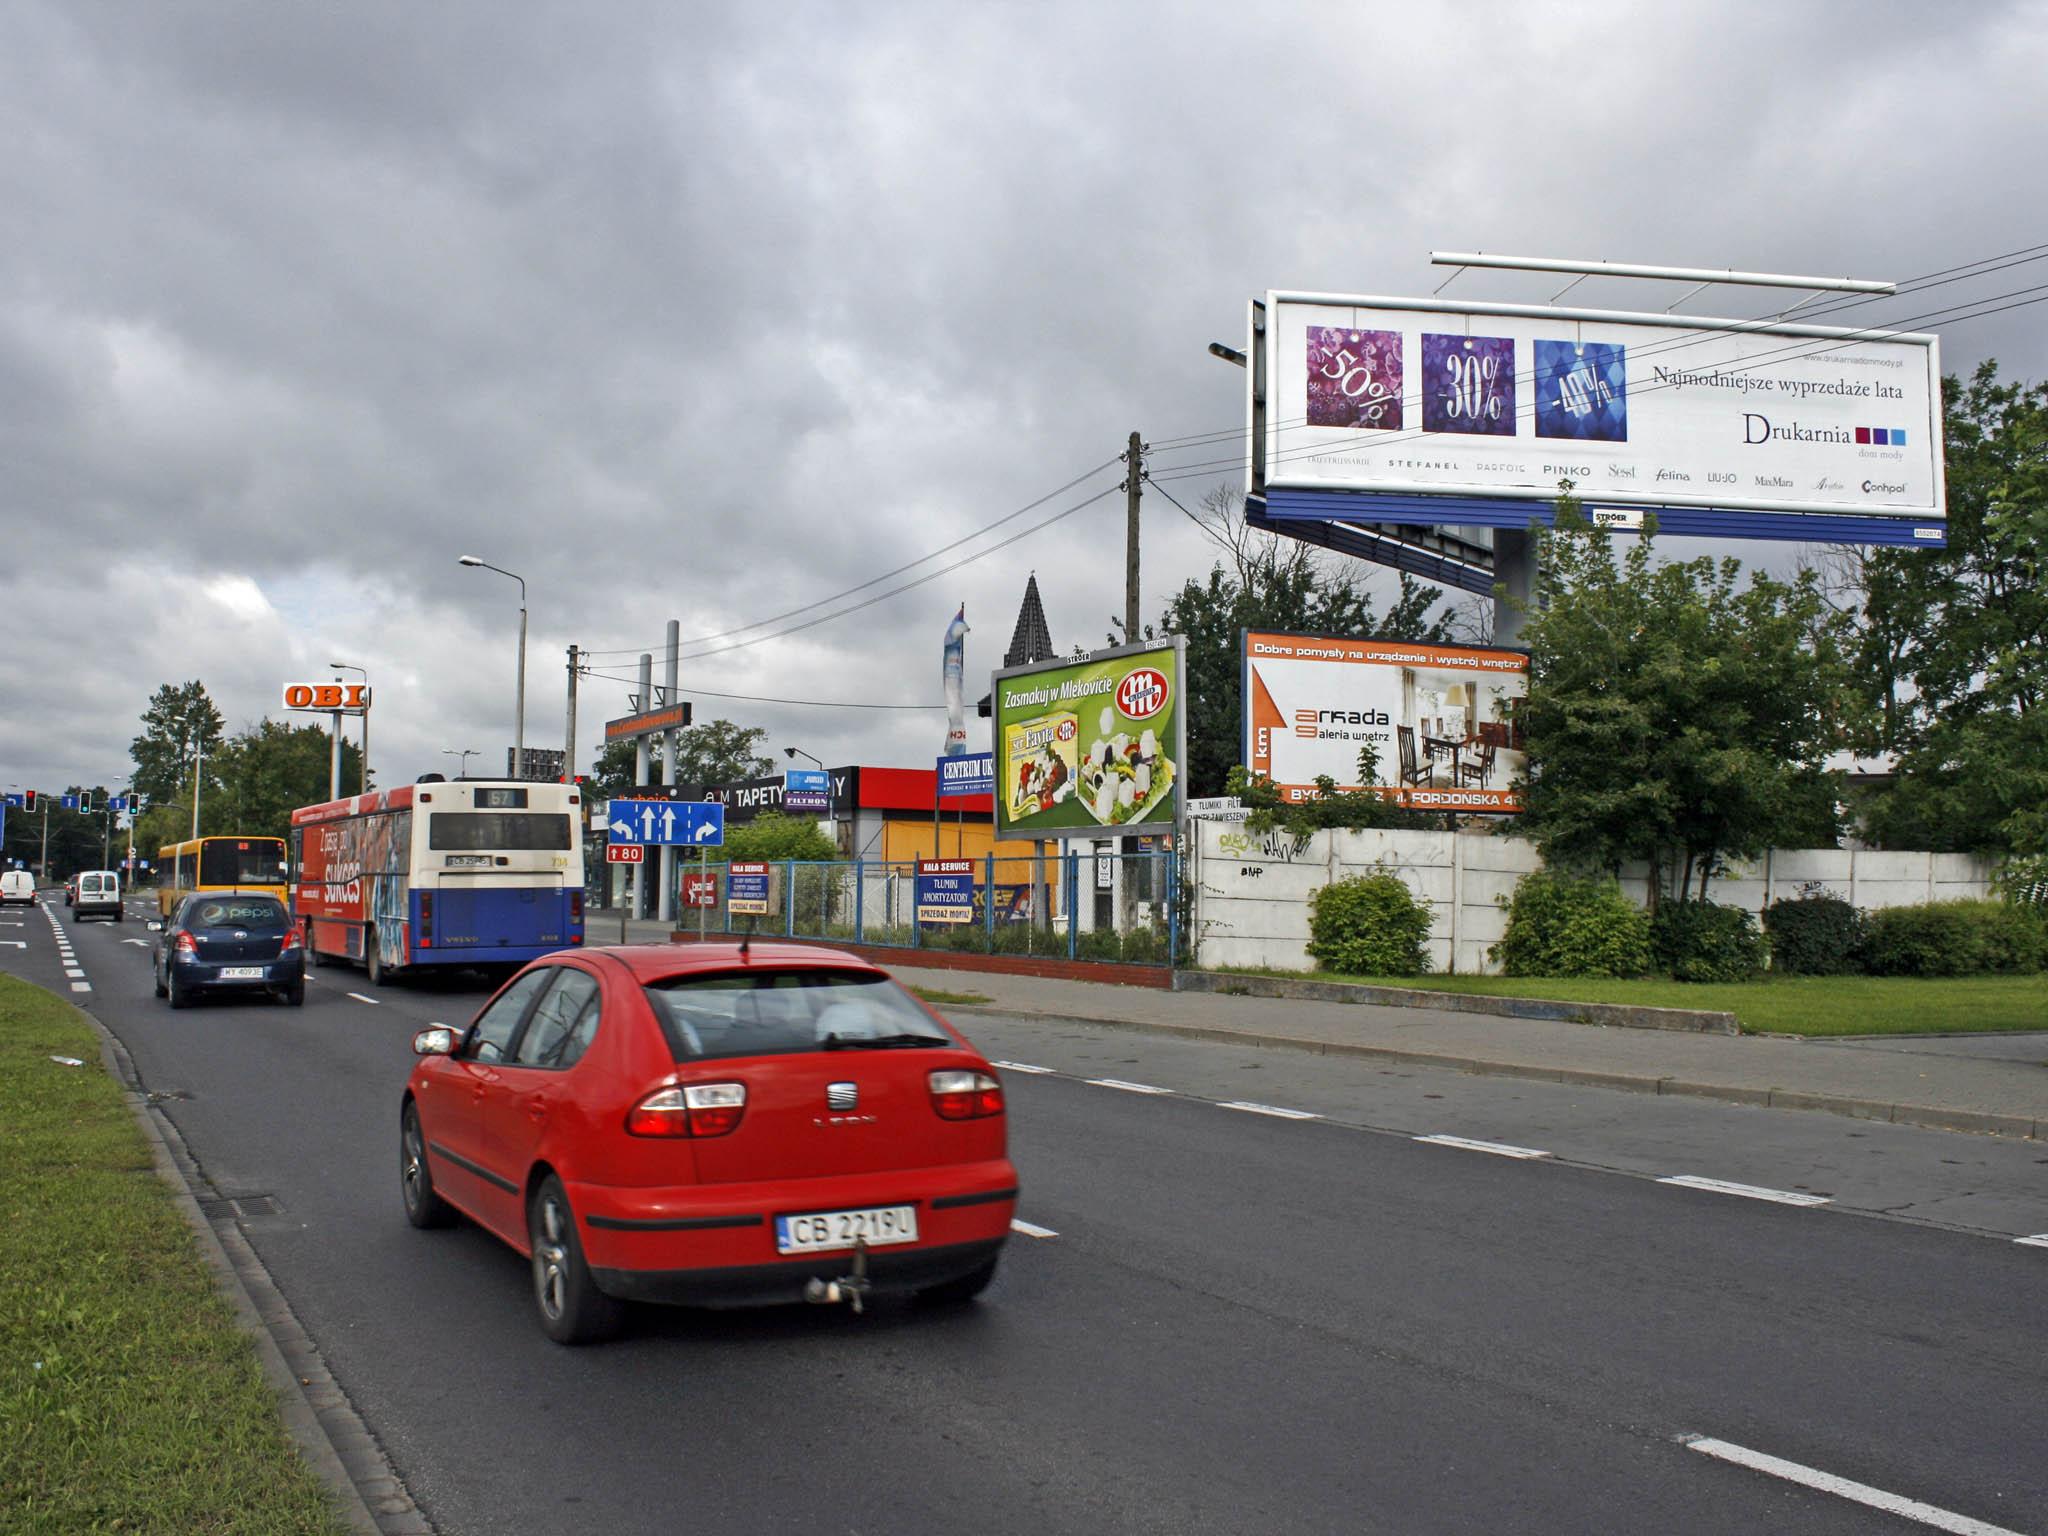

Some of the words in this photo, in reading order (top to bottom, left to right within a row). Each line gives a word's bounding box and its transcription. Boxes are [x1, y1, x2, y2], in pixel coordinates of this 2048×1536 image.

[1320, 347, 1393, 421] -50%
[1438, 354, 1501, 421] -30%
[1552, 363, 1613, 418] -40%
[1653, 366, 1774, 394] Najmodniejsze
[1778, 375, 1871, 399] wyprzedaże
[1875, 381, 1903, 399] lata
[1743, 413, 1851, 444] Drukarnia
[1388, 459, 1459, 470] STEFANEL
[1543, 465, 1591, 477] PINKO
[1656, 468, 1691, 482] felina
[1754, 475, 1794, 488] MaxMara
[1861, 480, 1905, 494] Conhpol
[1254, 643, 1293, 655] Dobre
[1296, 648, 1345, 659] pomysły
[1349, 651, 1363, 659] na
[1367, 652, 1426, 662] urządzenie
[1429, 654, 1433, 663] i
[1436, 656, 1479, 667] wystrój
[286, 685, 366, 707] OBI
[1005, 686, 1050, 708] Zasmakuj
[1050, 688, 1059, 701] w
[1060, 675, 1113, 698] Mlekovicie
[1255, 727, 1267, 758] km
[944, 760, 981, 779] CENTRUM
[736, 785, 785, 807] TAPETY
[1412, 790, 1500, 805] FORDOŃSKA
[622, 848, 639, 860] 80
[325, 850, 360, 904] sukces
[941, 862, 970, 872] SERVICE
[229, 907, 275, 919] pepsi
[793, 1217, 829, 1243] CB
